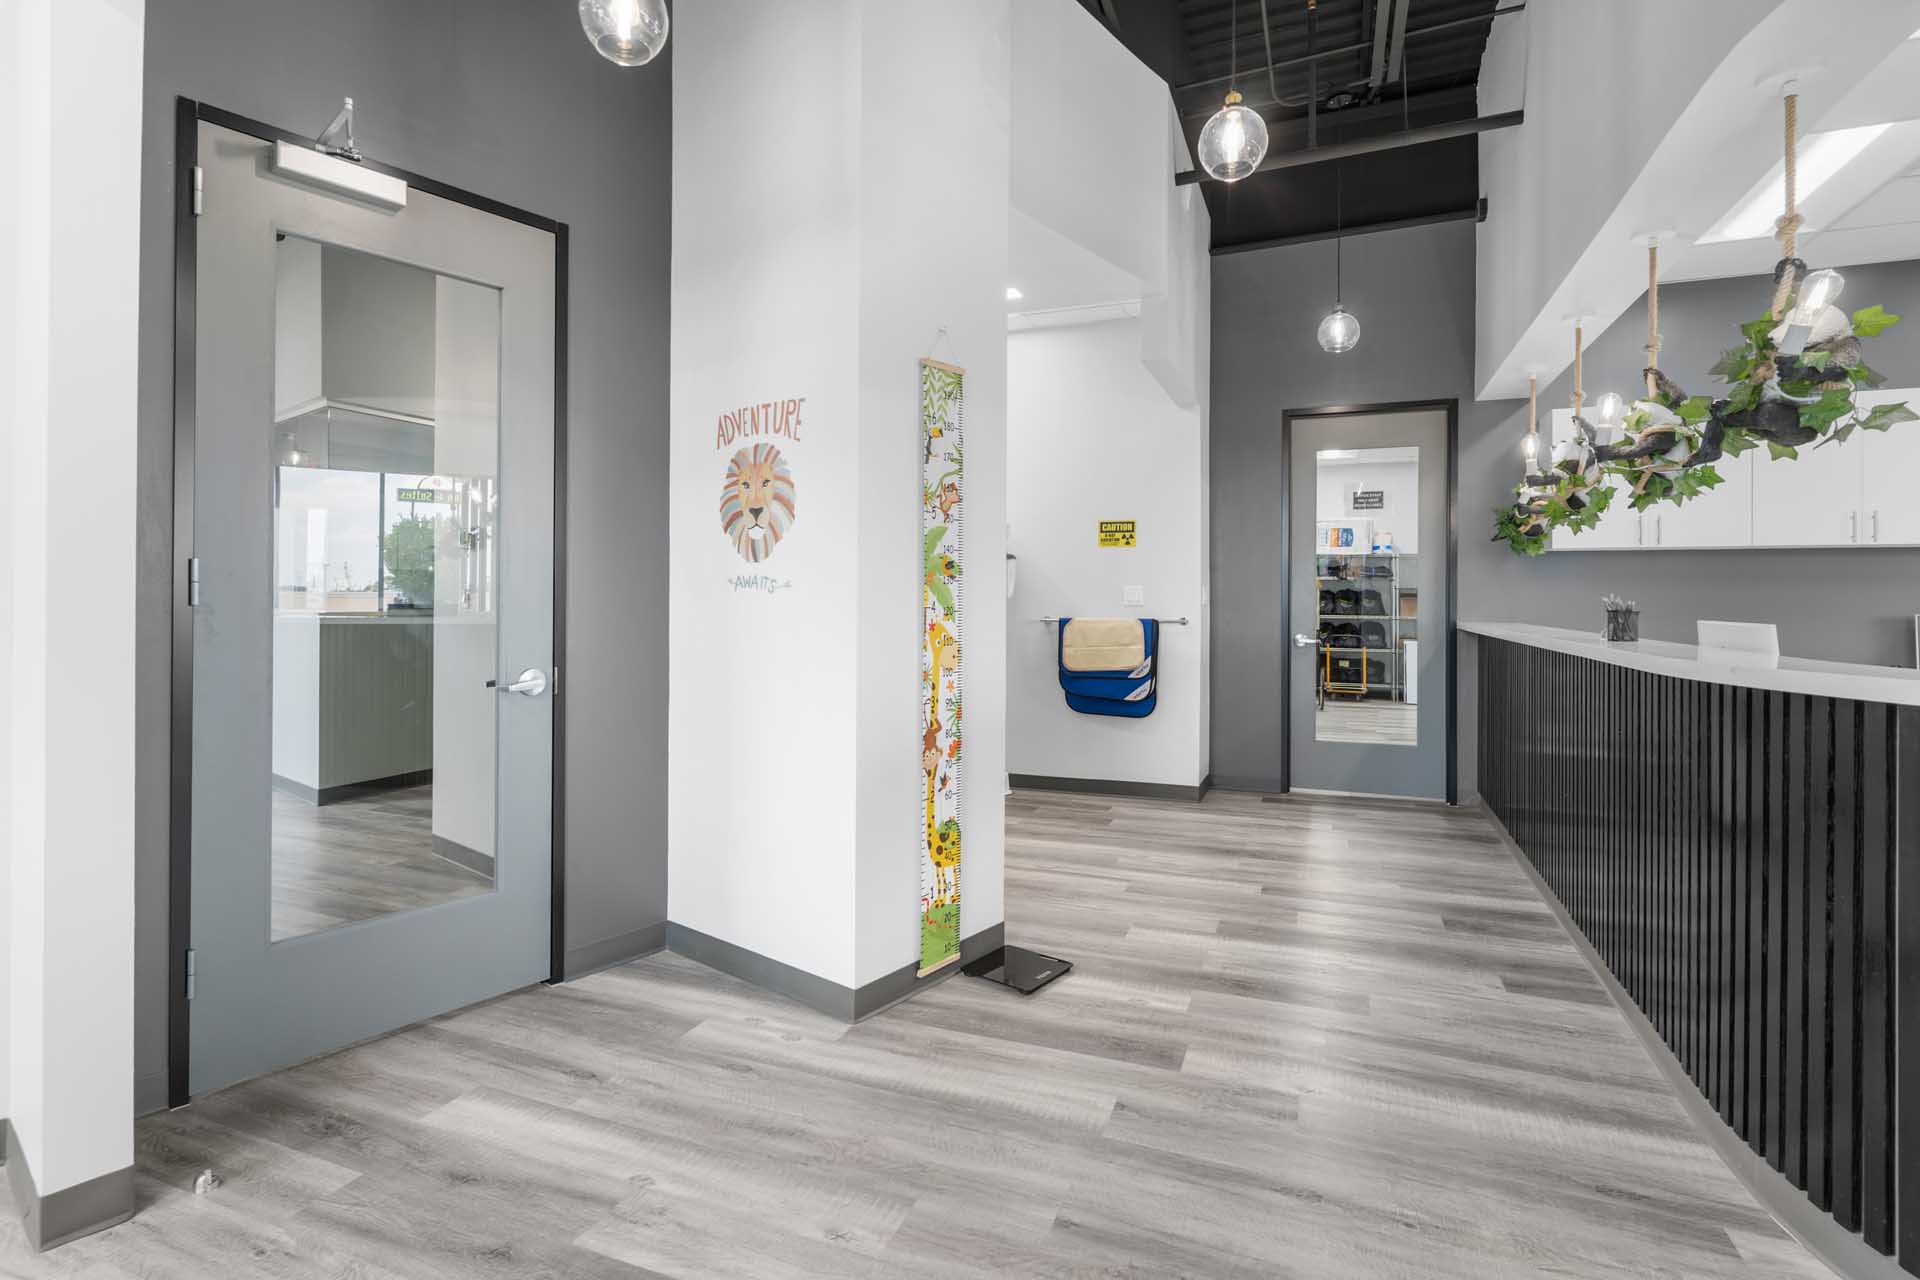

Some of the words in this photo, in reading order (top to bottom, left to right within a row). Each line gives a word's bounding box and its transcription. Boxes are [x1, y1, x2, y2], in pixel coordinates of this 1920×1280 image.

[716, 398, 806, 450] ADVENTURE
[932, 413, 937, 425] 6
[944, 422, 955, 431] 180
[1102, 523, 1133, 531] CAUTION
[943, 545, 954, 554] 140
[734, 575, 777, 594] AWAITS
[943, 575, 954, 584] 130
[931, 601, 936, 612] 4
[945, 698, 953, 707] 90
[945, 728, 953, 738] 80
[945, 760, 953, 769] 70
[945, 791, 953, 800] 60
[944, 851, 952, 861] 40
[930, 887, 934, 900] 1
[944, 912, 951, 922] 20
[944, 943, 951, 953] 10
